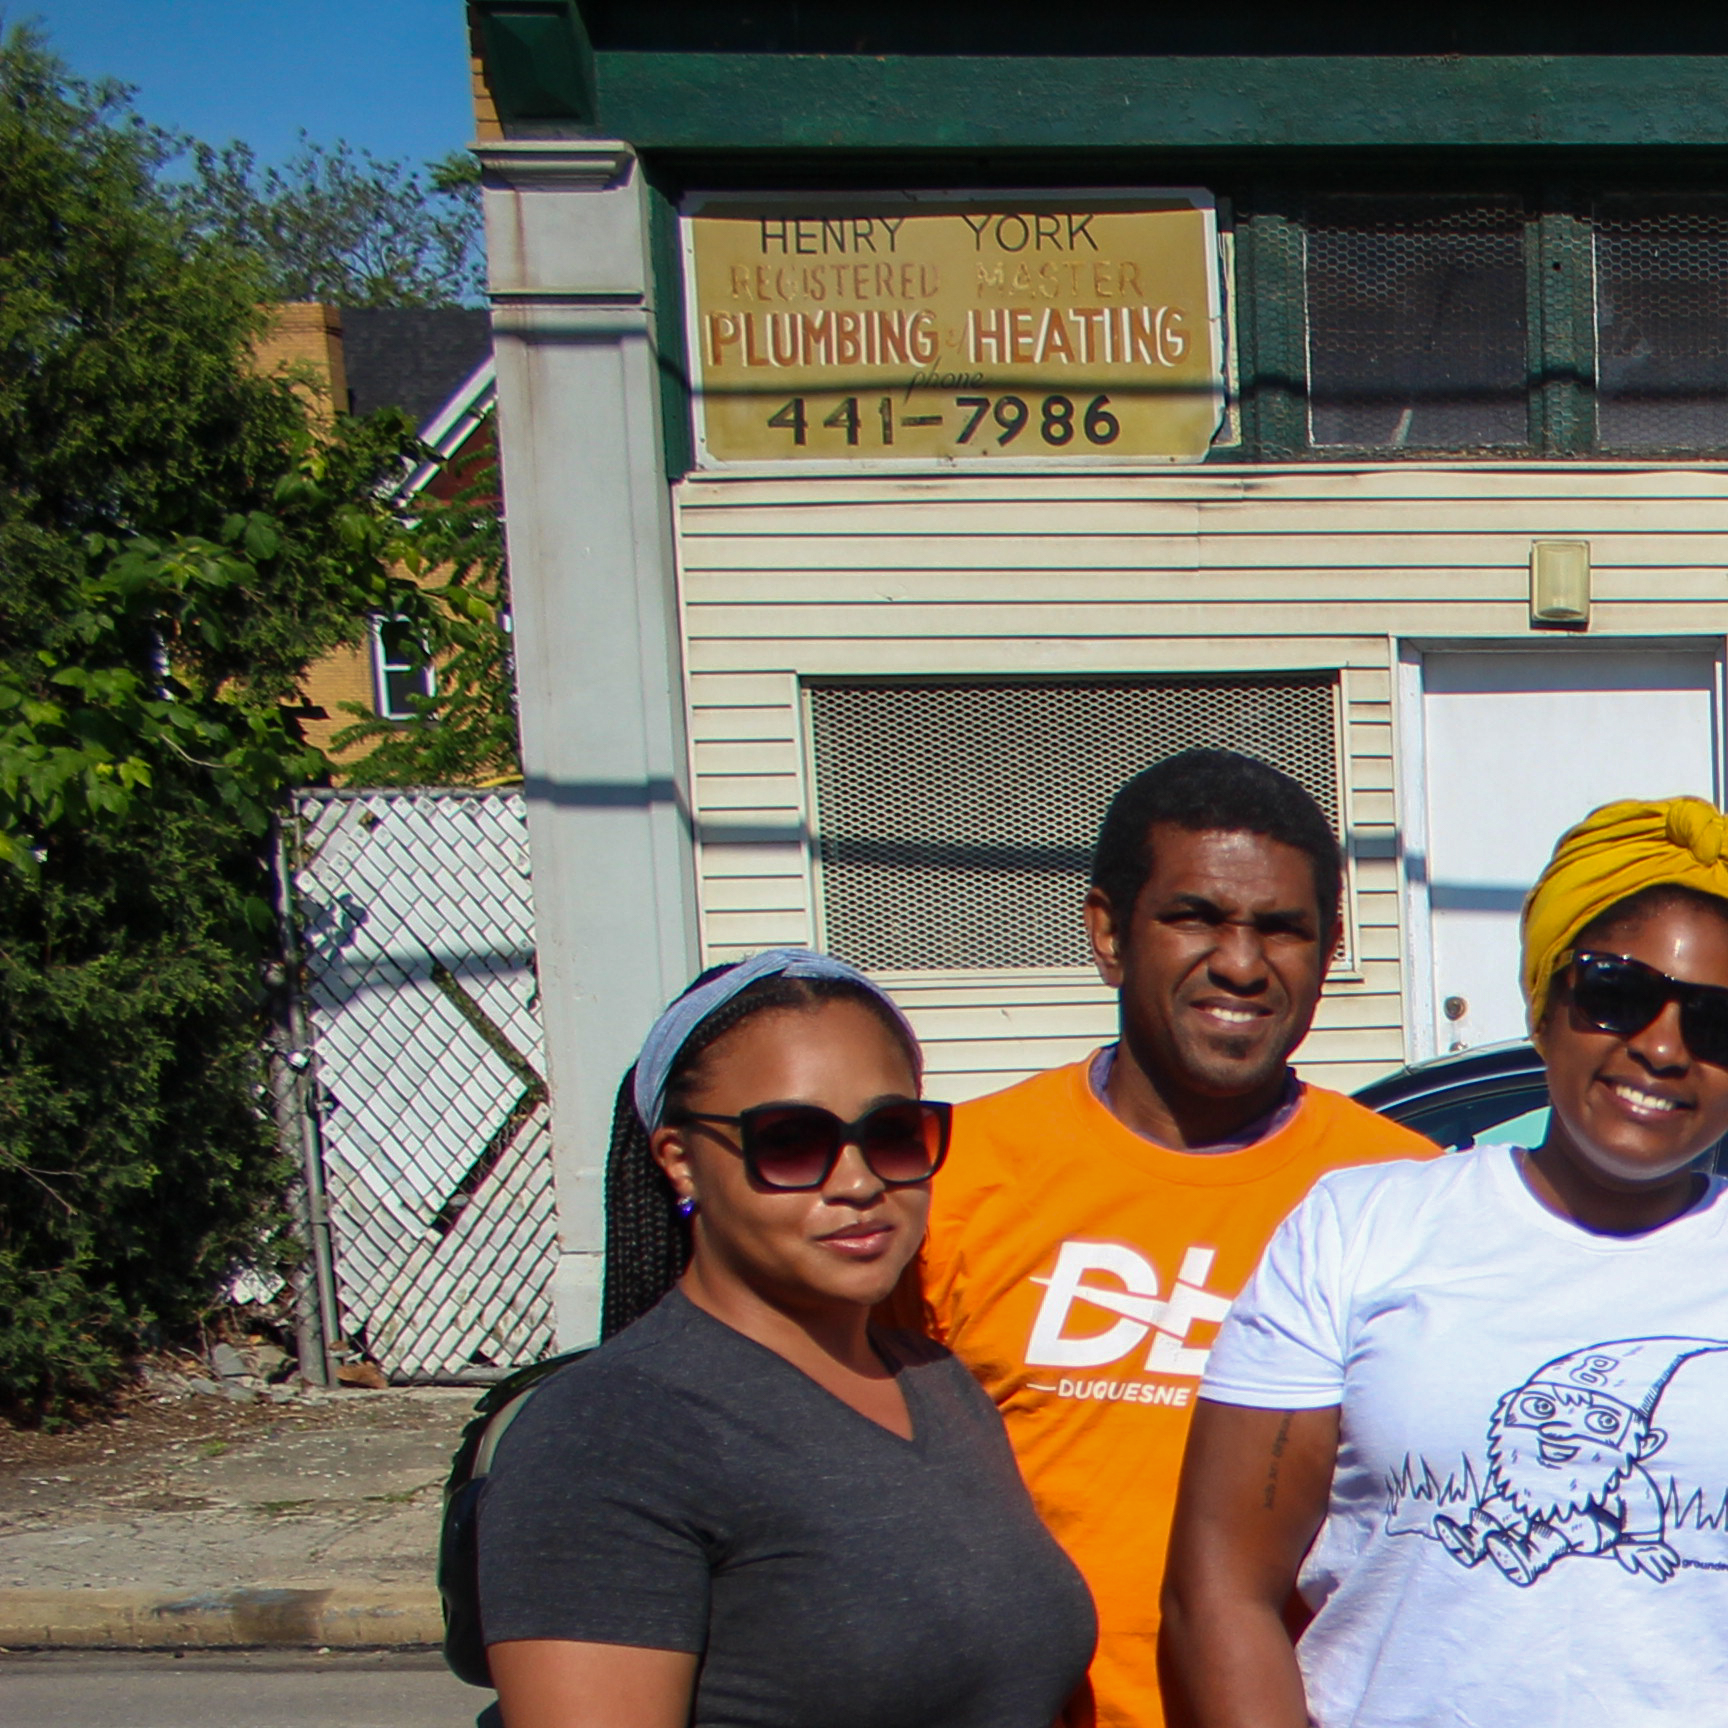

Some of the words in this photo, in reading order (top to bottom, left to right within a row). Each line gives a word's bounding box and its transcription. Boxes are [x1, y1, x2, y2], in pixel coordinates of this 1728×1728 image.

[760, 214, 904, 254] HENRY
[962, 213, 1099, 252] YORK
[731, 262, 939, 300] REGISTERED
[976, 261, 1144, 299] MASTER
[705, 308, 939, 367] PLUMBING
[967, 305, 1192, 365] HEATING
[904, 356, 984, 406] phone
[767, 394, 1121, 447] 441-7986
[1024, 1241, 1232, 1376] DL
[1058, 1378, 1191, 1406] DUQUESNE
